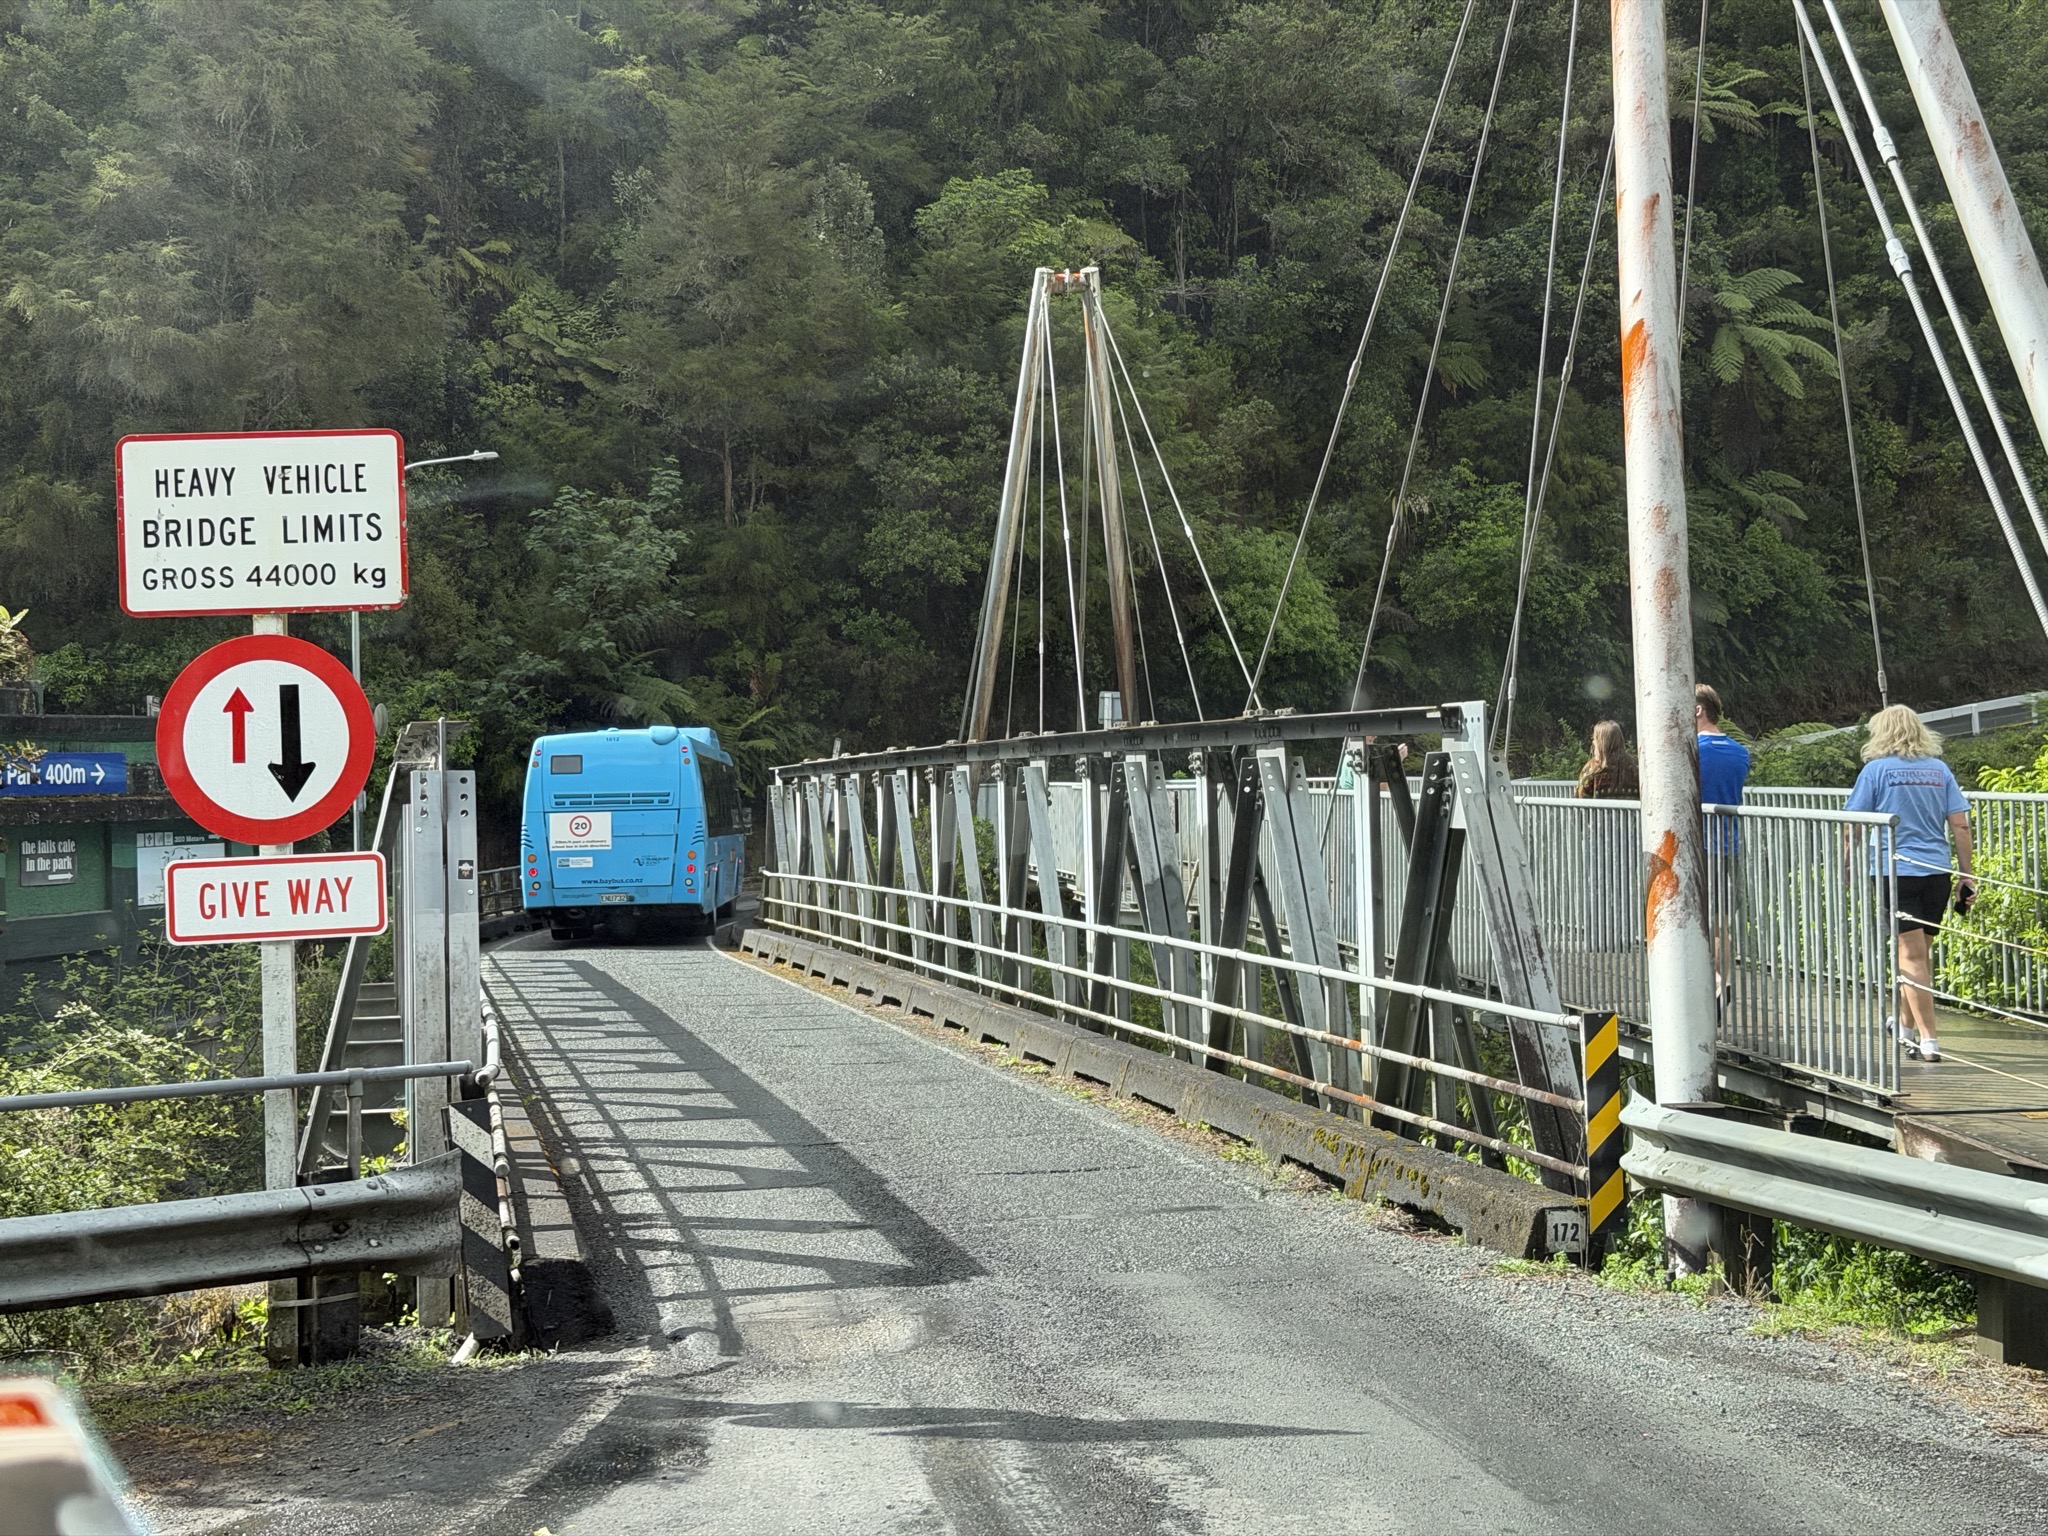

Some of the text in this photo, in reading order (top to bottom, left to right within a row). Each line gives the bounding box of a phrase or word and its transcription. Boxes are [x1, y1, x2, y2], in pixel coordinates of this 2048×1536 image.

[155, 463, 368, 499] HEAVY VEHICLE
[143, 512, 383, 549] BRIDGE LIMITS
[142, 562, 387, 591] GROSS 44000 kg
[45, 763, 86, 785] 400m
[574, 822, 588, 830] 20
[21, 838, 76, 855] the falls cafe
[26, 855, 73, 872] in the park
[199, 876, 353, 920] GIVE WAY
[1552, 1222, 1580, 1242] 172
